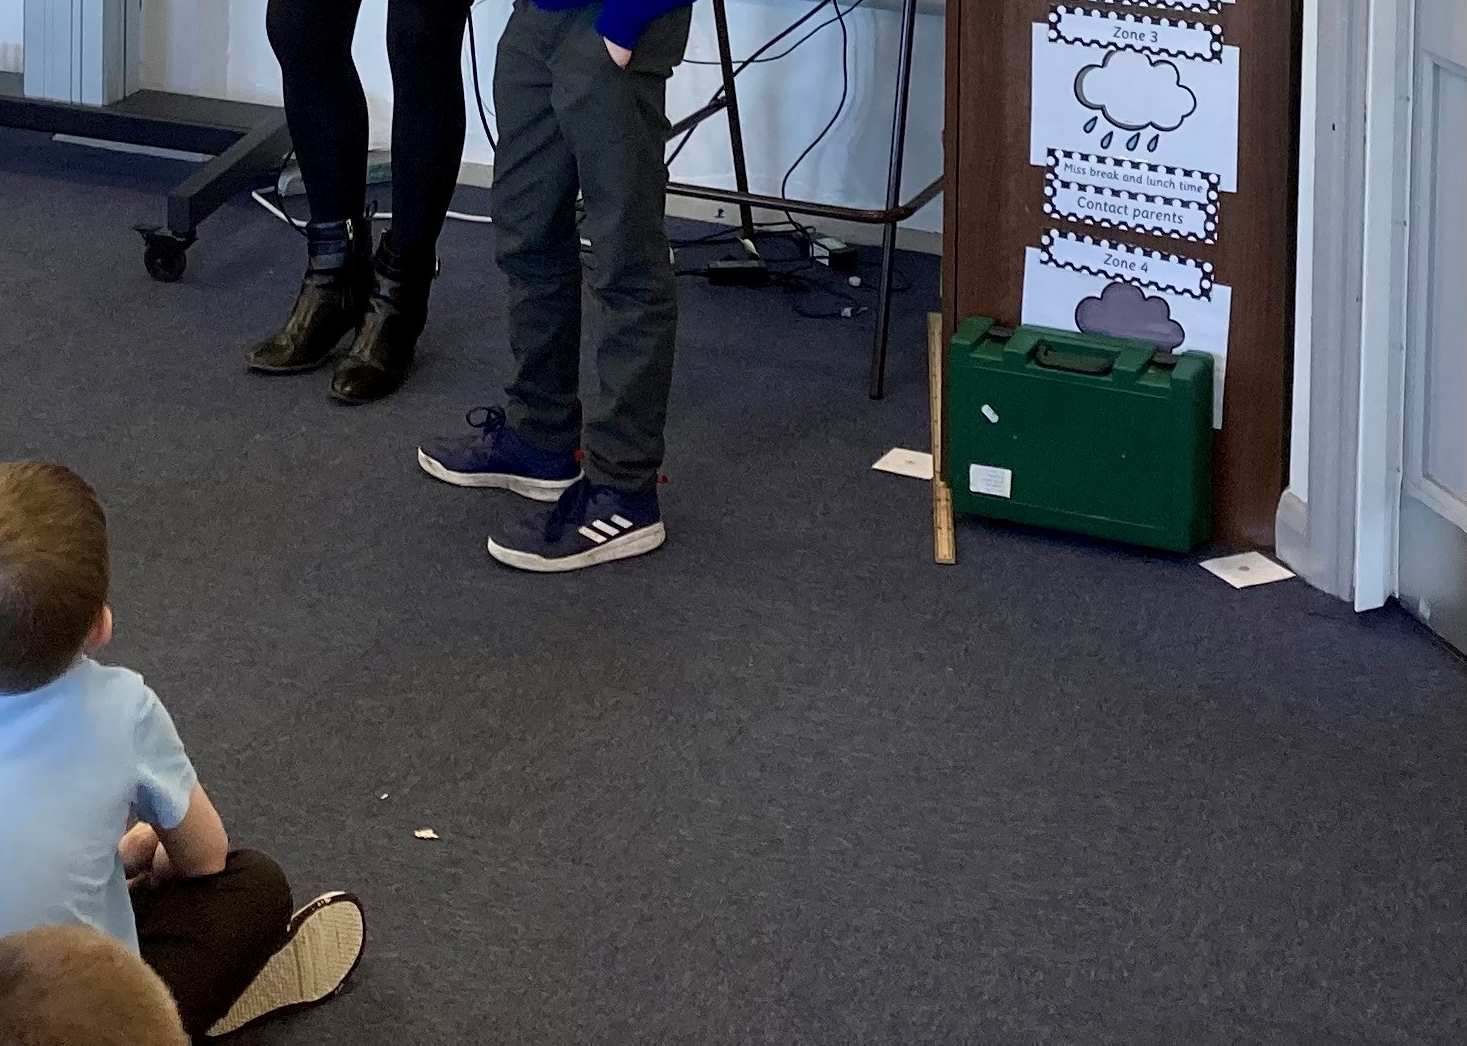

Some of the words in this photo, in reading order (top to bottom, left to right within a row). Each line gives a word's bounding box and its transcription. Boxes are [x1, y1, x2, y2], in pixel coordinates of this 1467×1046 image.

[1112, 26, 1145, 42] Zone
[1150, 30, 1159, 44] 3
[1063, 162, 1087, 179] Miss
[1089, 165, 1120, 183] break
[1123, 170, 1144, 186] and
[1146, 173, 1177, 190] lunch
[1179, 178, 1204, 195] time
[1077, 196, 1129, 216] Contact
[1132, 203, 1185, 225] parents
[1103, 253, 1136, 273] Zone
[1140, 260, 1149, 274] 4
